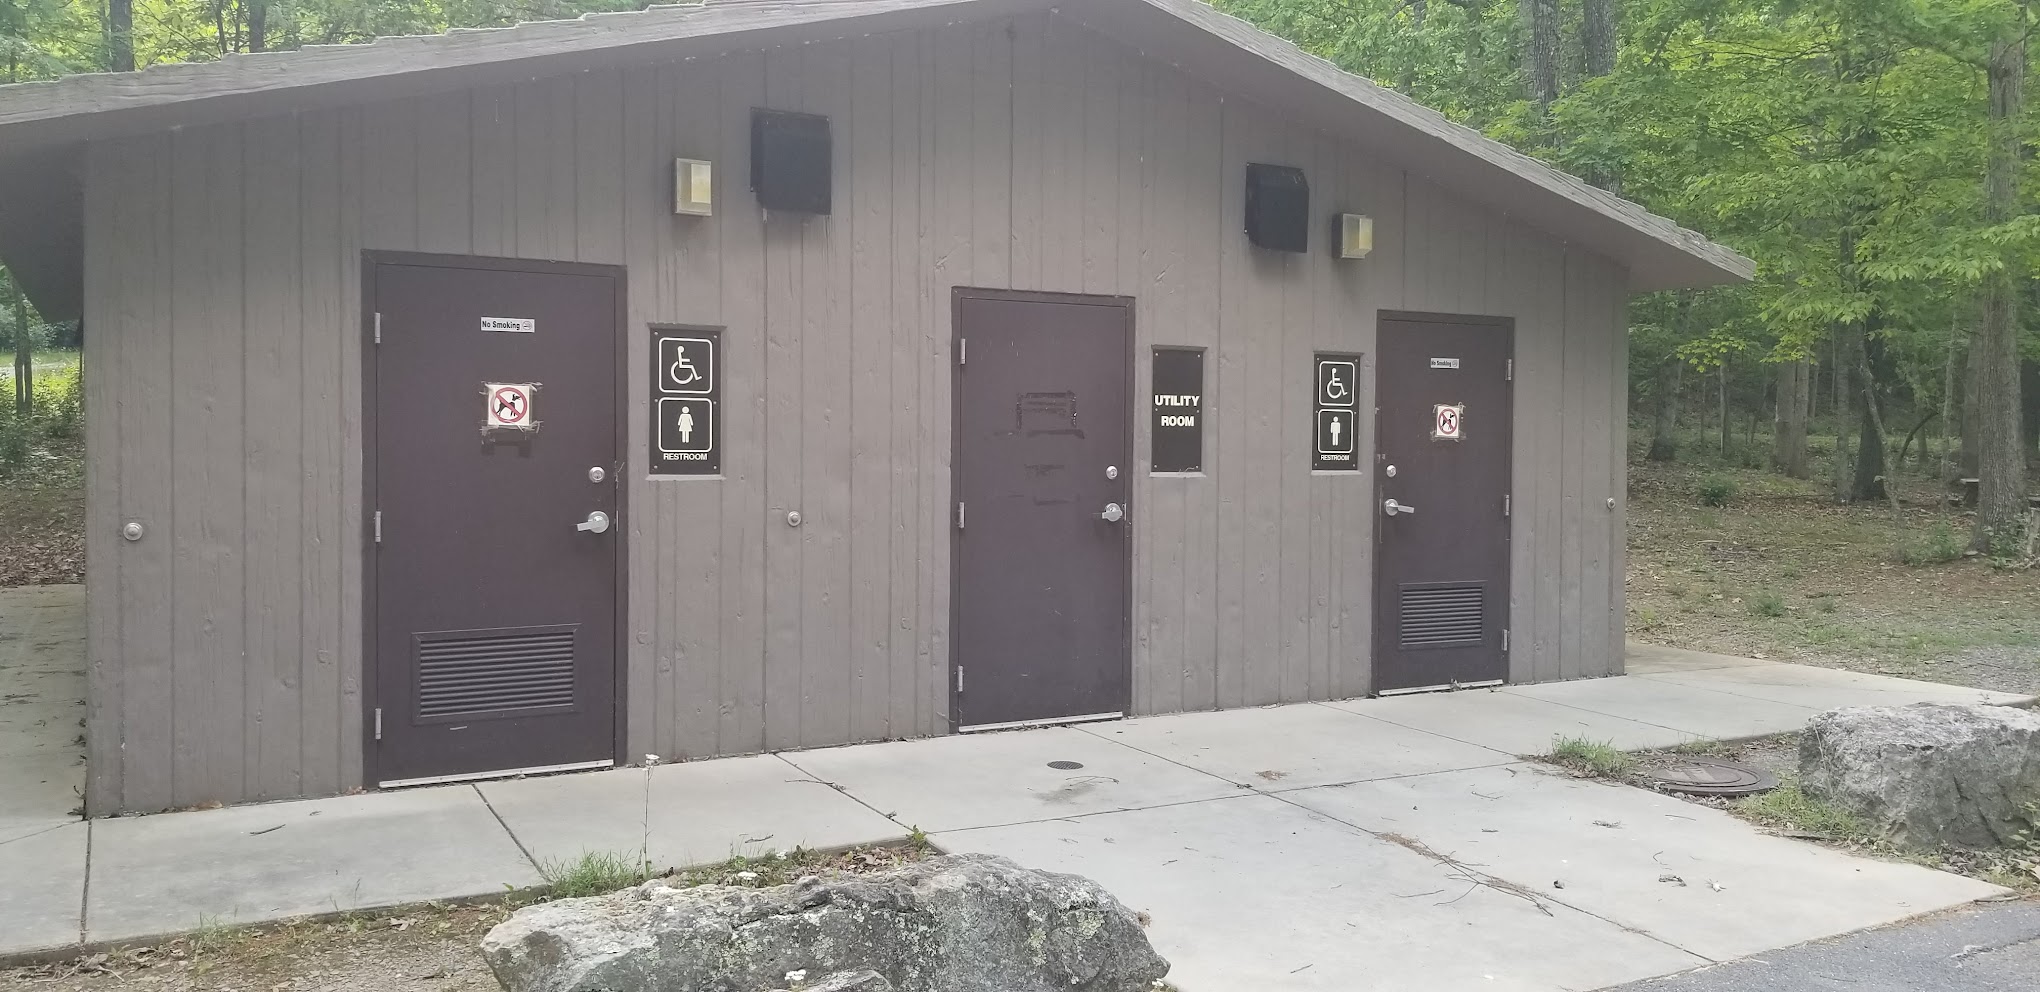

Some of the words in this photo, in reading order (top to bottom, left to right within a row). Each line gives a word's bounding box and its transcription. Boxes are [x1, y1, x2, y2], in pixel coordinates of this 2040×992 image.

[482, 320, 491, 328] No
[492, 320, 521, 331] Smoking
[1154, 394, 1200, 407] UTILITY
[1160, 415, 1195, 427] ROOM
[663, 452, 709, 461] RESTROOM
